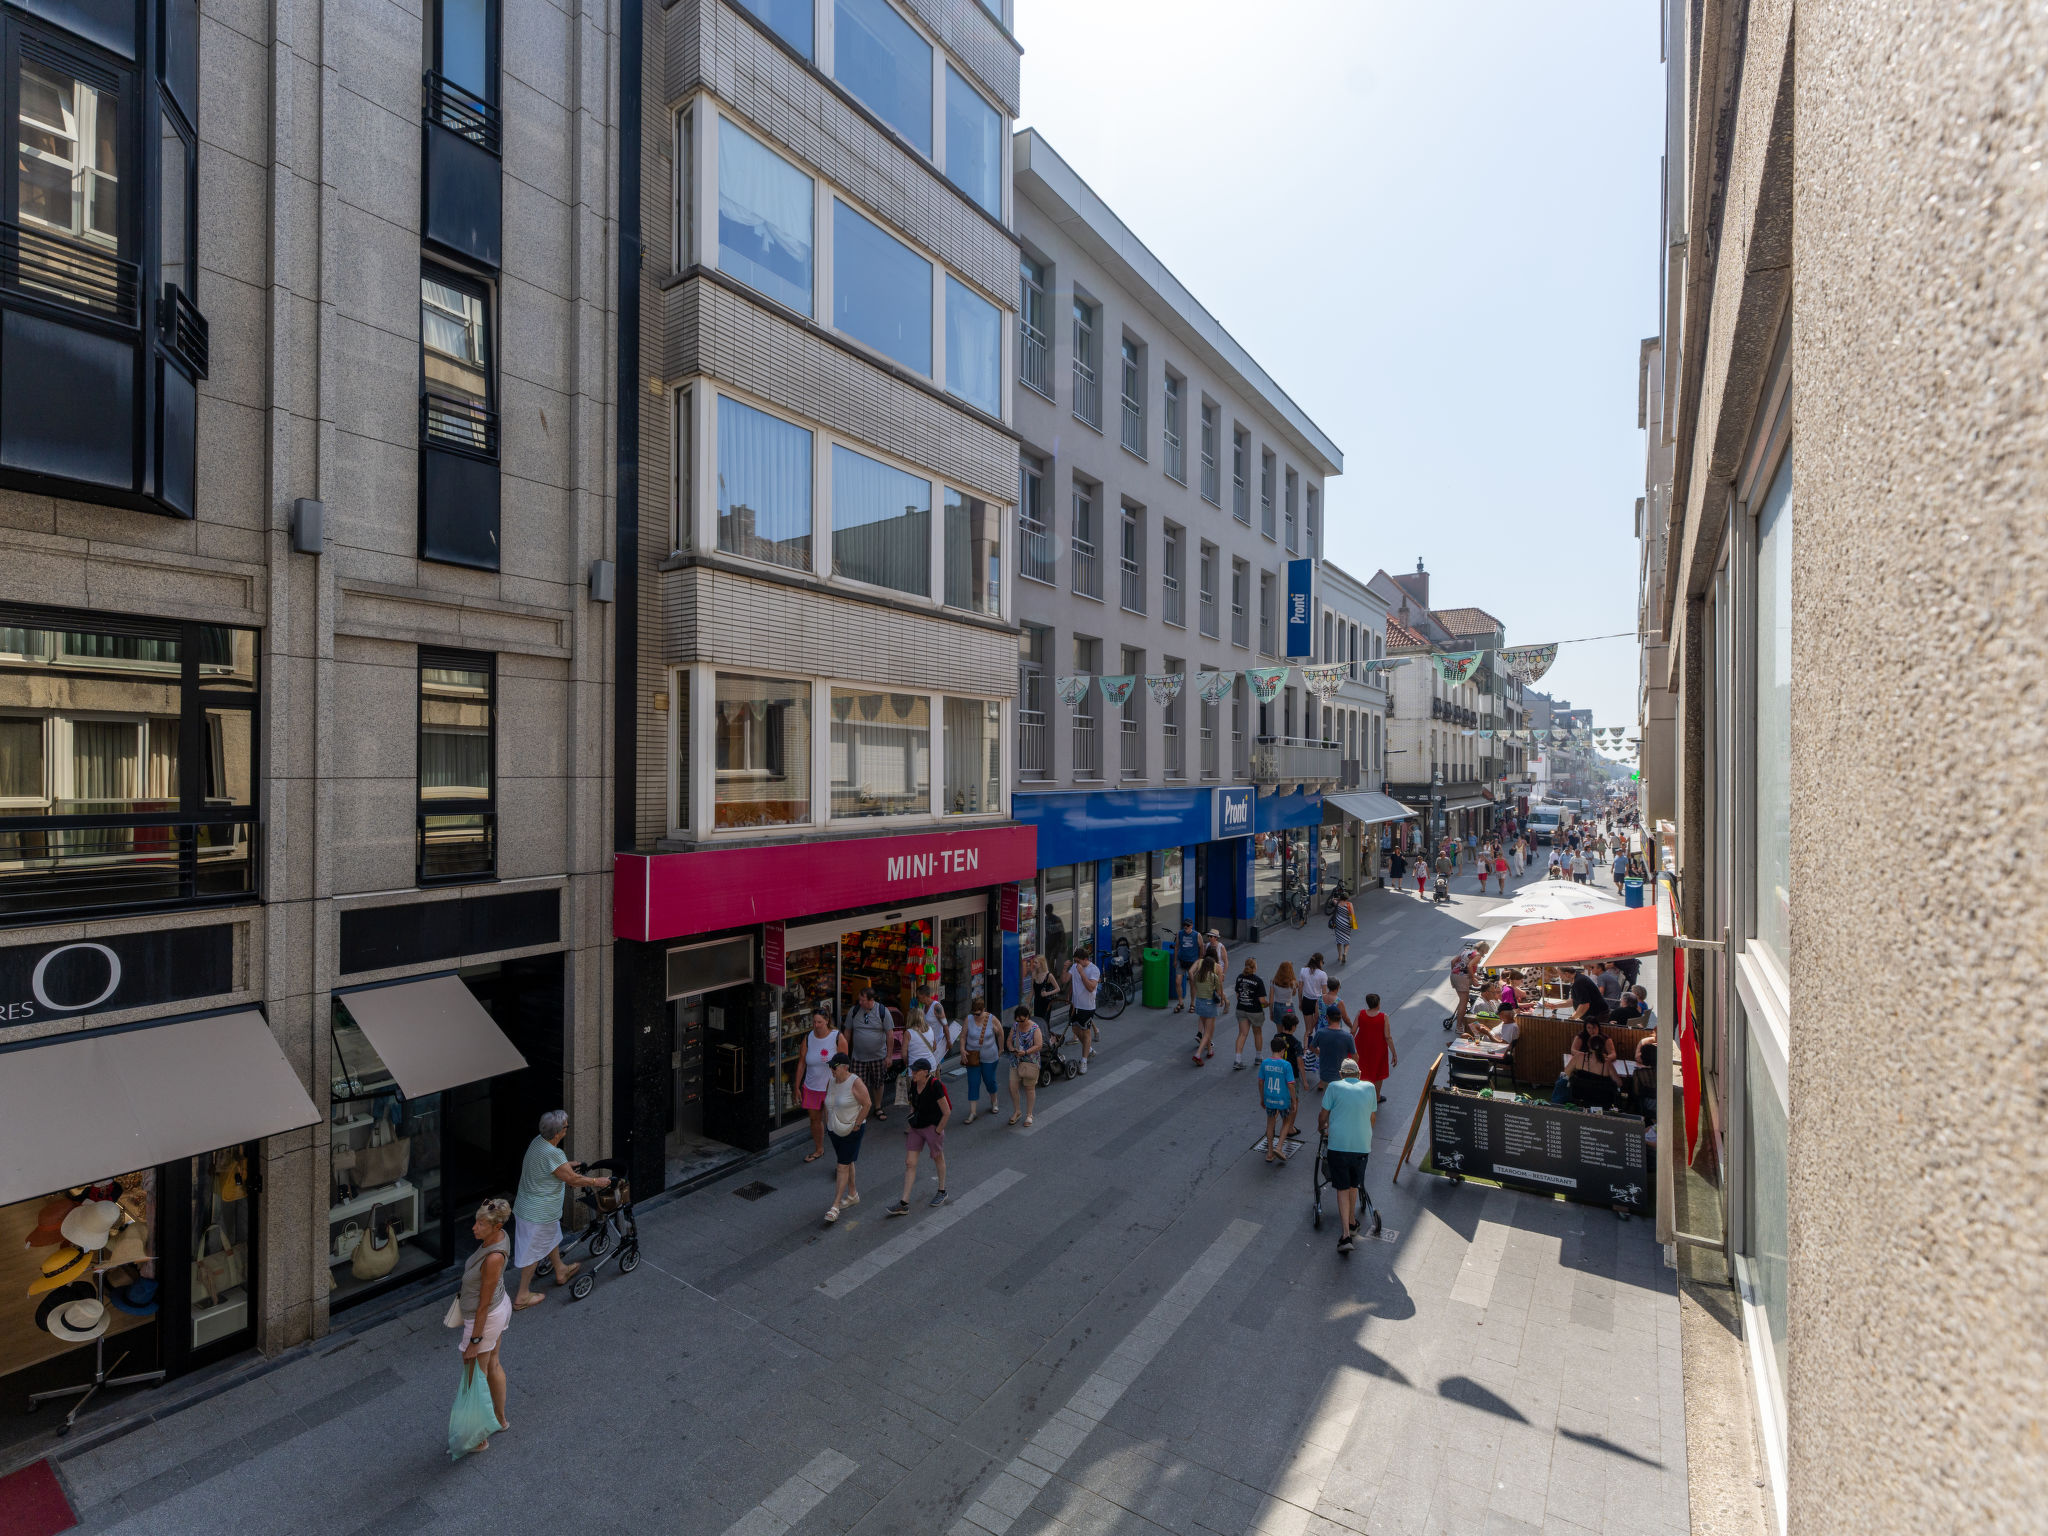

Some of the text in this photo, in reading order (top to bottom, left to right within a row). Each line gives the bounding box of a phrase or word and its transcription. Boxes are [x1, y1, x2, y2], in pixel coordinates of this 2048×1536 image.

[1290, 593, 1305, 624] Pronti
[1224, 794, 1248, 825] Pronti
[887, 847, 979, 882] MINI-TEN
[1102, 917, 1109, 927] 38
[32, 942, 121, 1010] O
[1268, 1077, 1280, 1094] 44
[1497, 1166, 1527, 1176] TEAROOM
[1532, 1171, 1573, 1185] RESTAURANT
